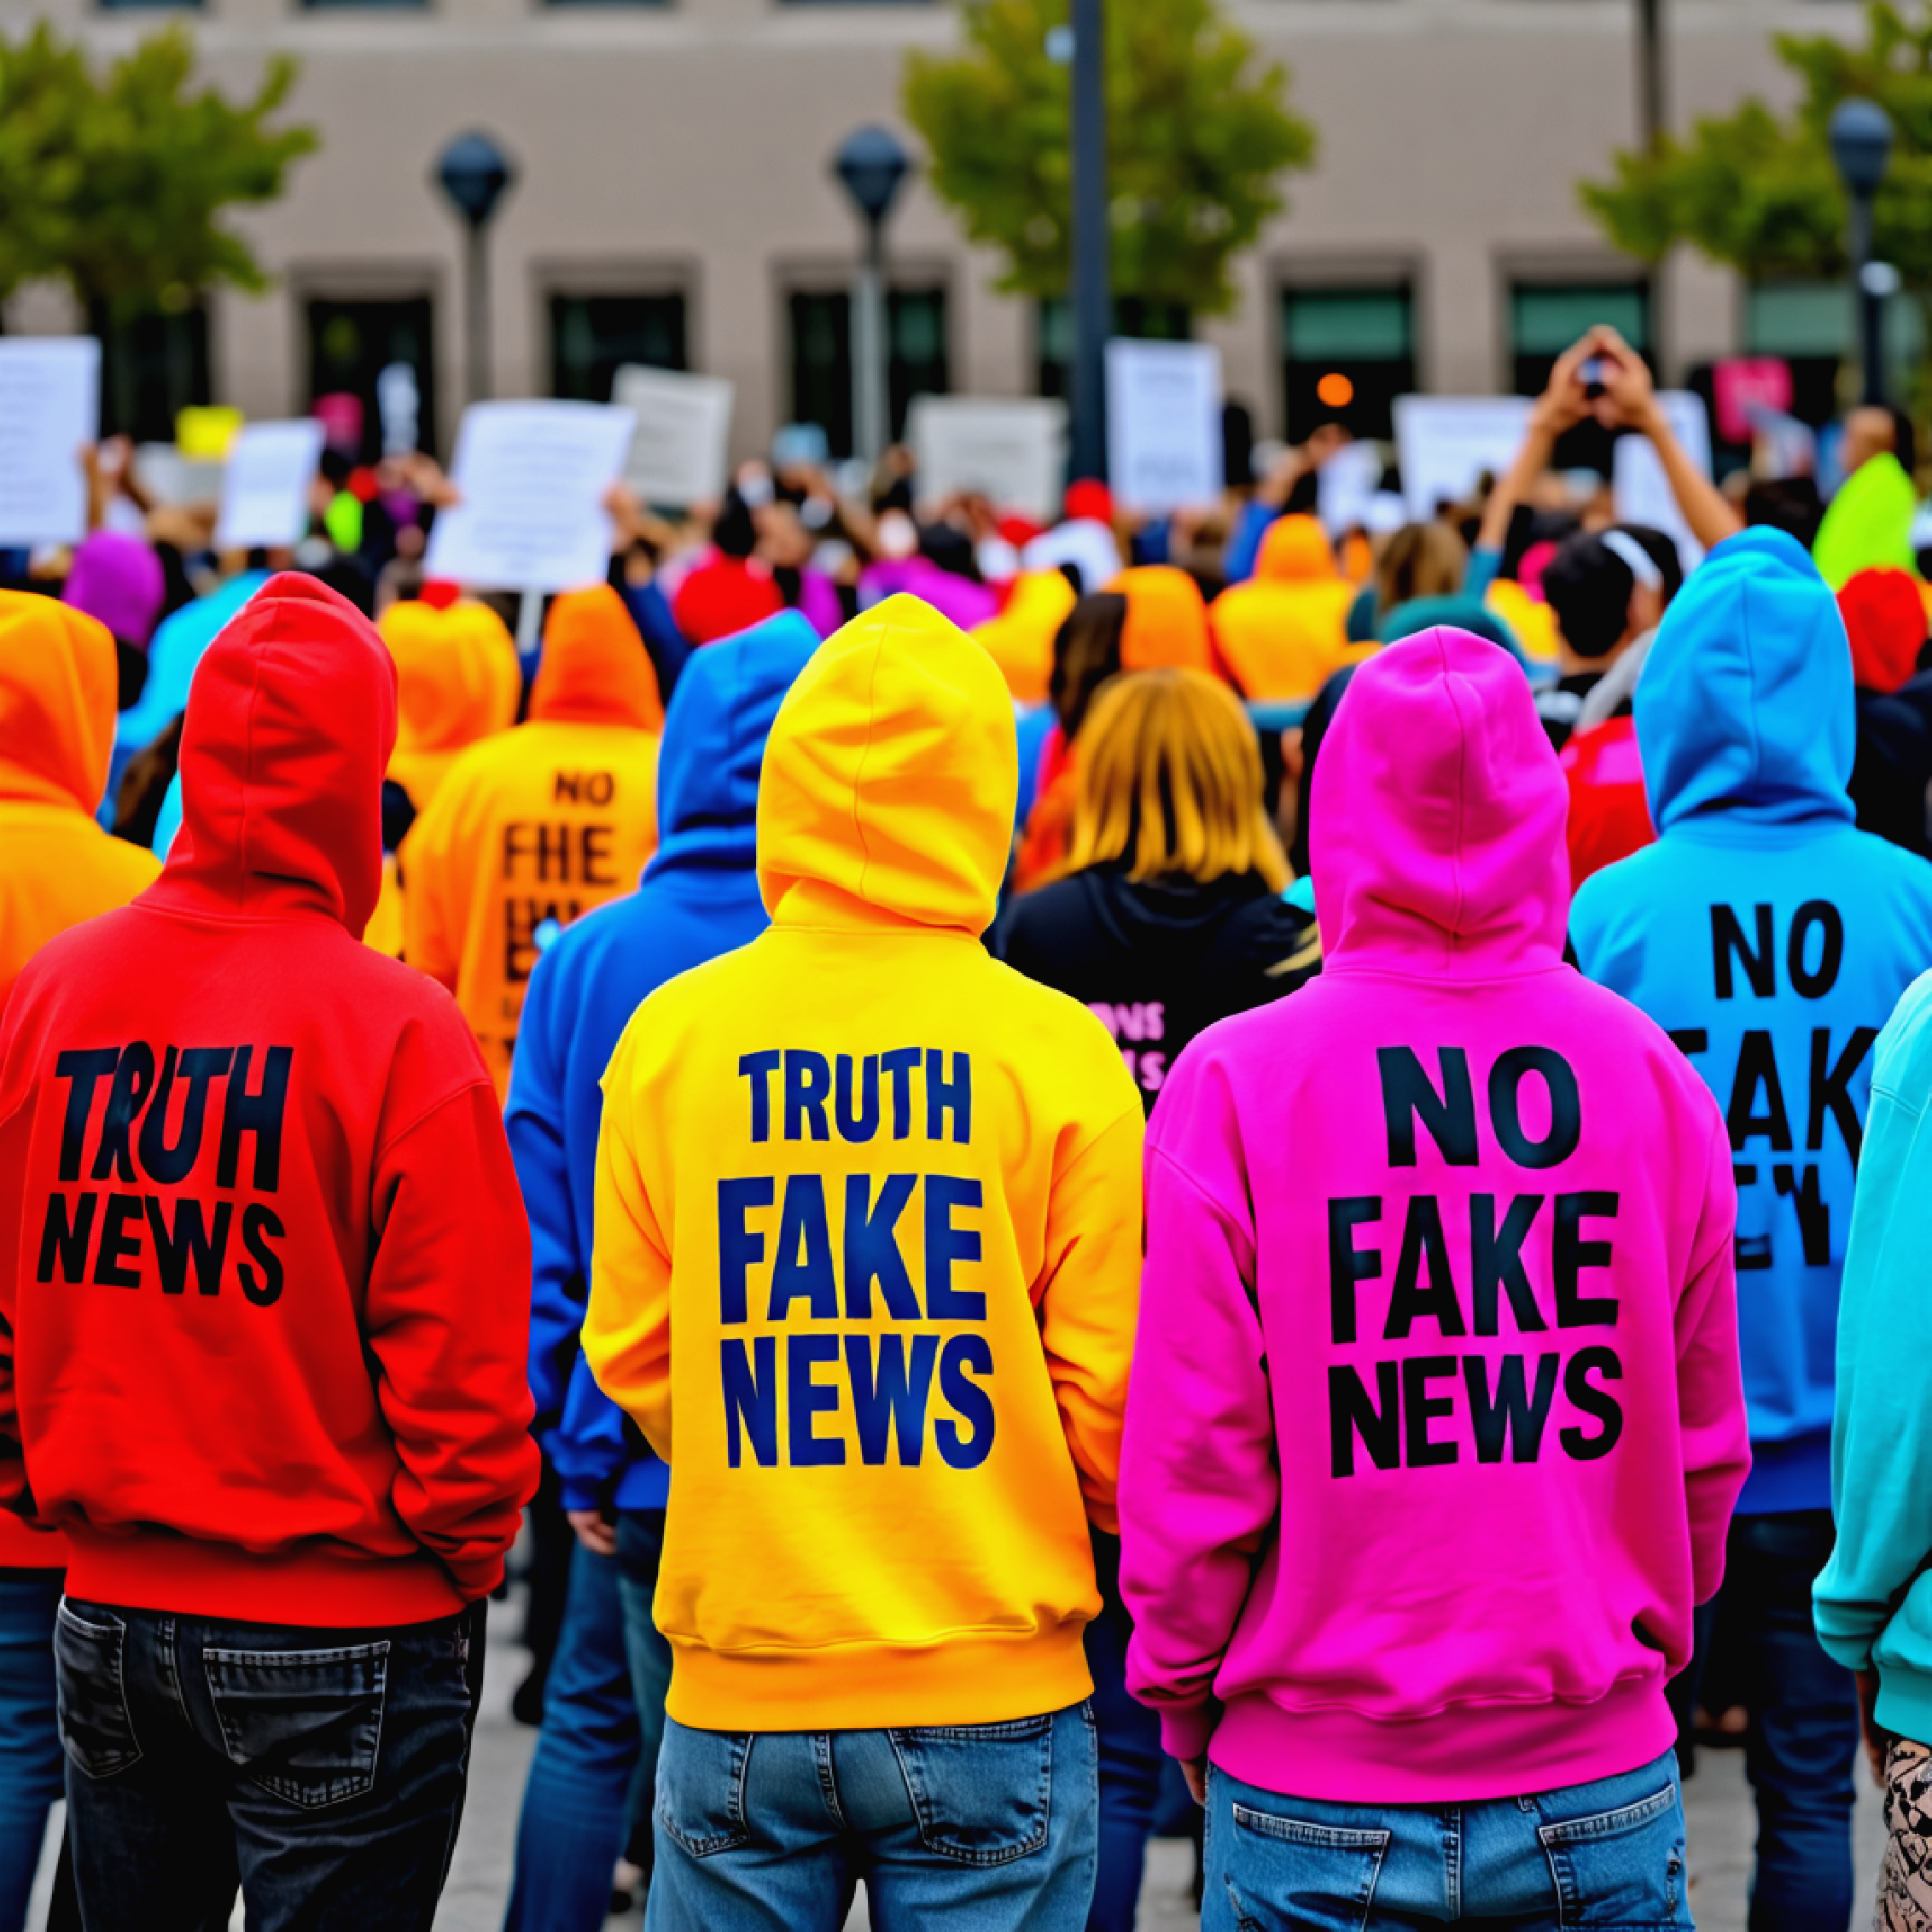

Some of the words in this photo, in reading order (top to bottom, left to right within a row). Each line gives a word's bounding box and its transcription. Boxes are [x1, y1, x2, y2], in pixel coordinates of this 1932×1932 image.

[553, 771, 615, 806] NO
[1710, 899, 1844, 1000] NO
[55, 1040, 294, 1193] TRUTH
[738, 1046, 972, 1145] TRUTH
[1376, 1045, 1581, 1170] NO
[37, 1192, 287, 1307] NEWS
[718, 1173, 987, 1324] FAKE
[1327, 1191, 1621, 1345] FAKE
[719, 1333, 995, 1470] NEWS
[1327, 1345, 1623, 1480] NEWS
